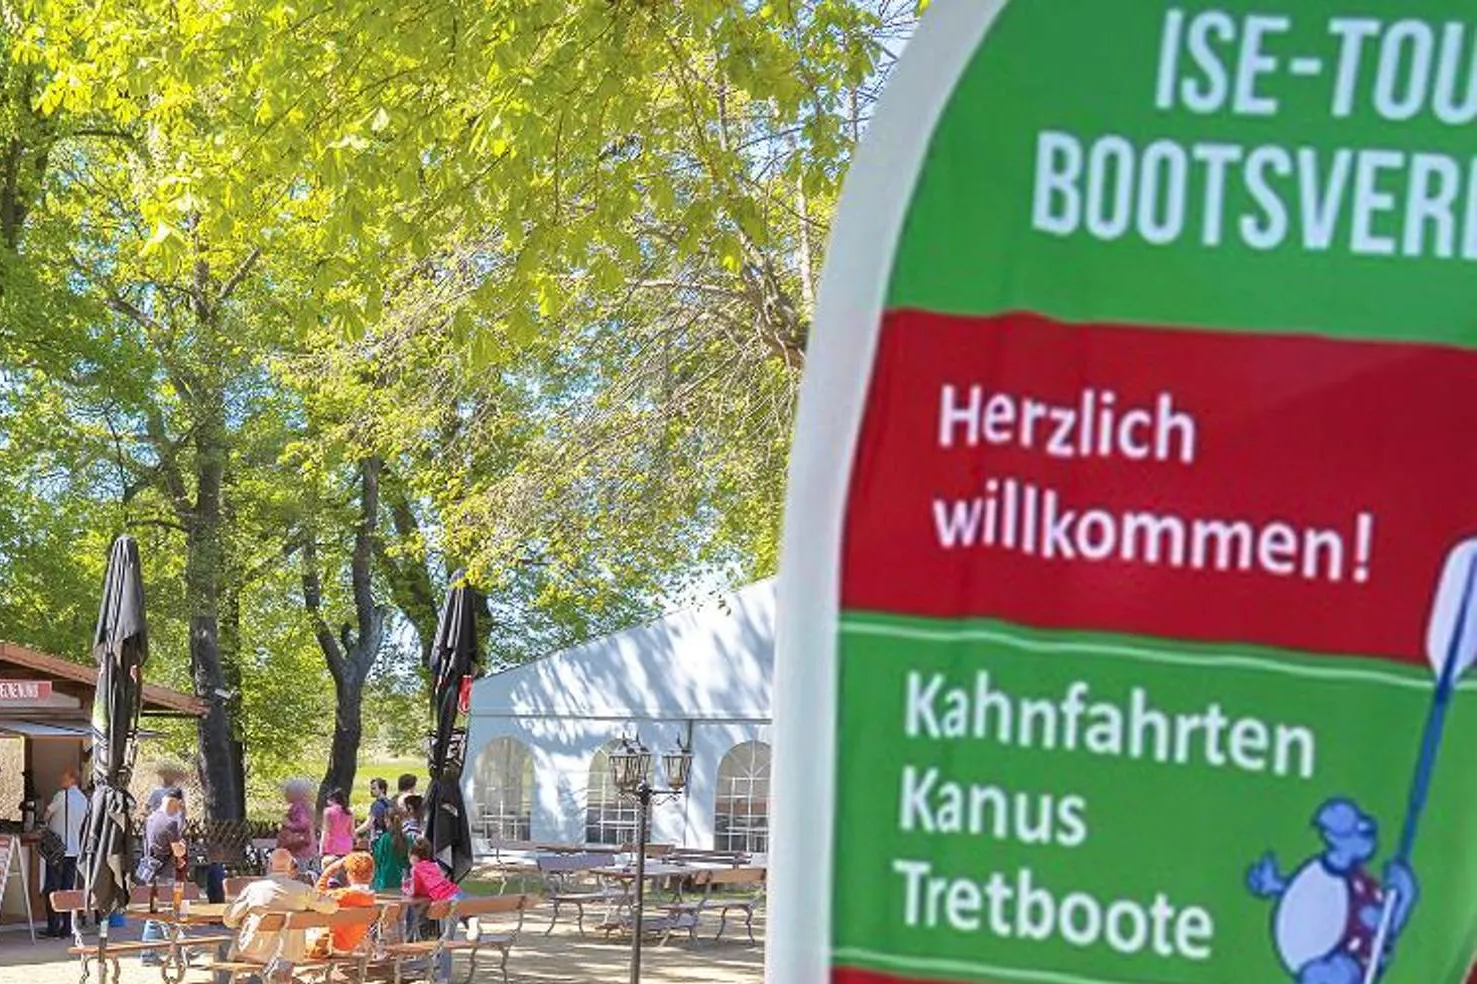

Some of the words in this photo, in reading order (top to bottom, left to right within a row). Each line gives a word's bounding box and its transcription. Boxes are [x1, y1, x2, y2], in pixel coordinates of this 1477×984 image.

[1156, 9, 1477, 124] ISE-TOU
[938, 384, 1196, 463] Herzlich
[933, 478, 1373, 582] willkommen!
[904, 670, 1316, 779] Kahnfahrten
[899, 765, 1088, 847] Kanus
[892, 859, 1214, 959] Tretboote
